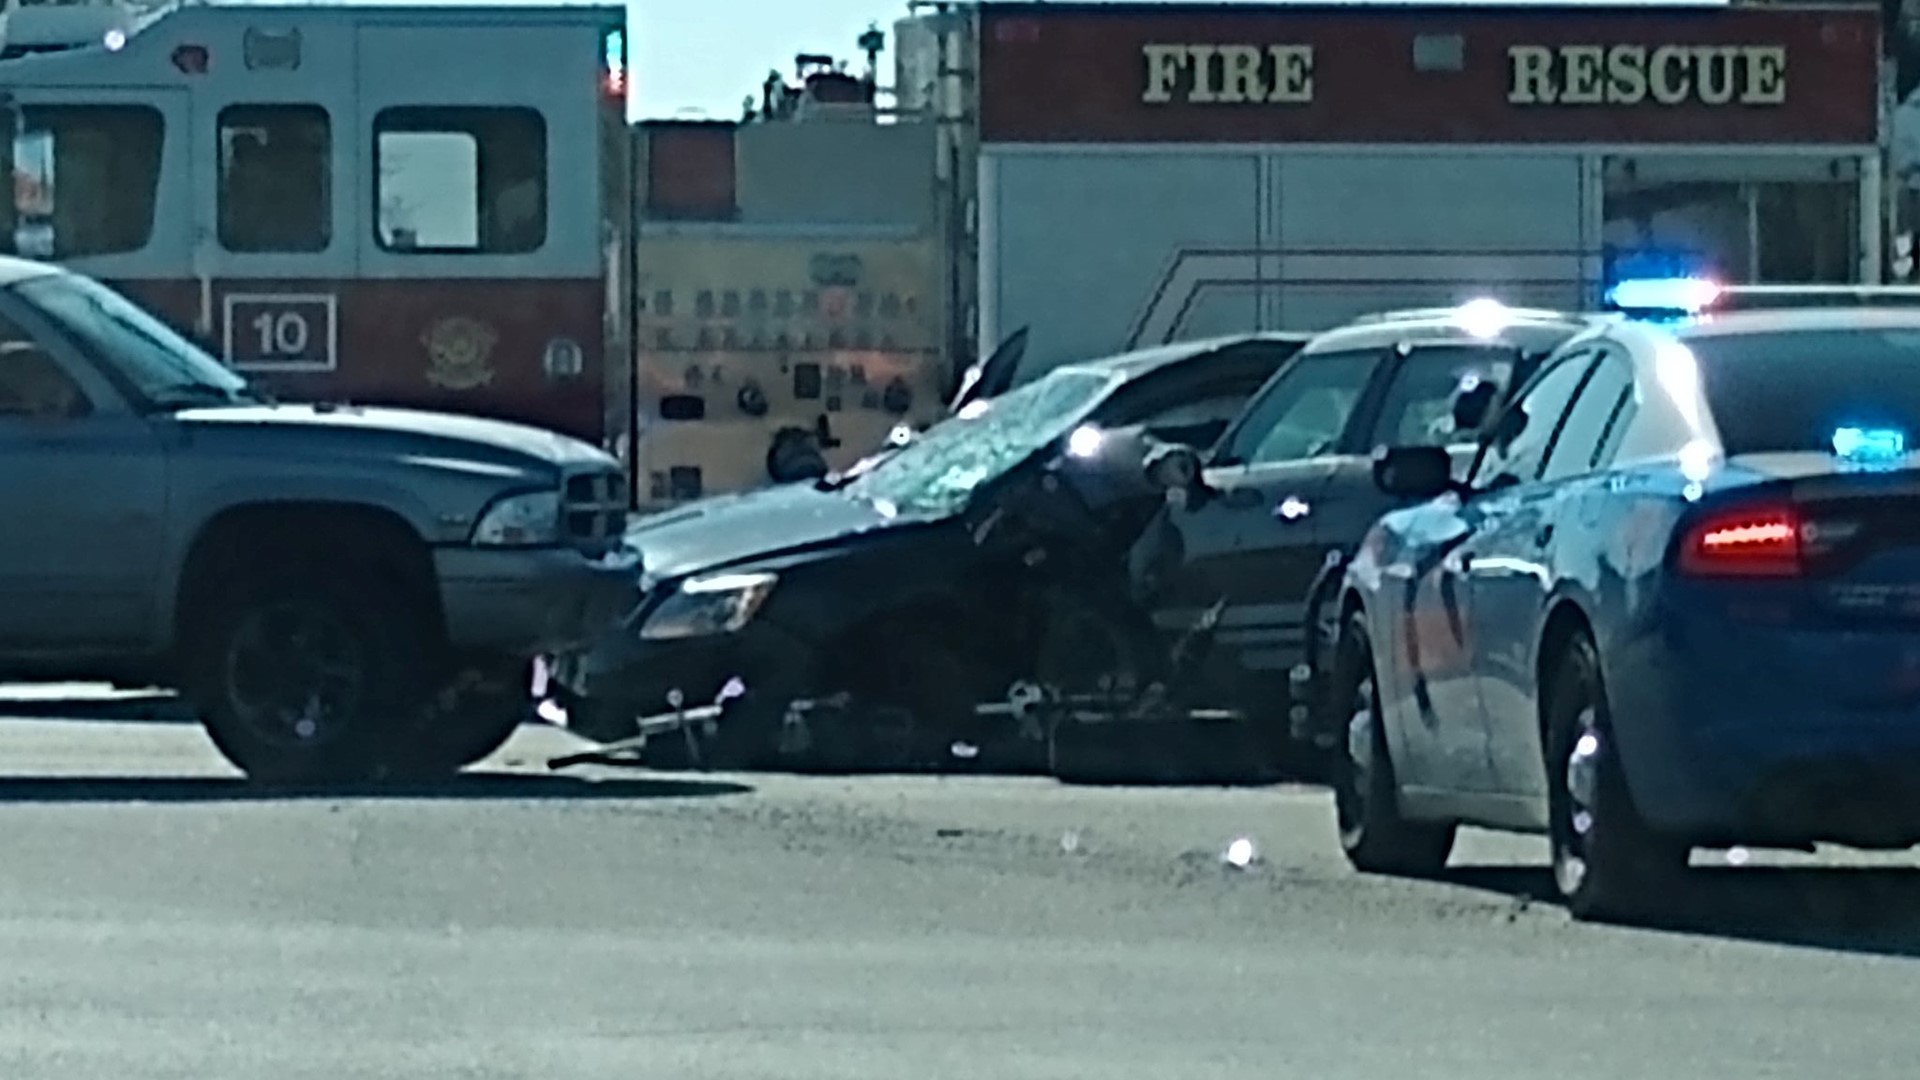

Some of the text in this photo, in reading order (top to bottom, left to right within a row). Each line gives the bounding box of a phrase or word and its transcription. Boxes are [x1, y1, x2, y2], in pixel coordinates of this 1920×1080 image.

[1142, 44, 1787, 105] FIRE RESCUE
[252, 311, 309, 355] 10
